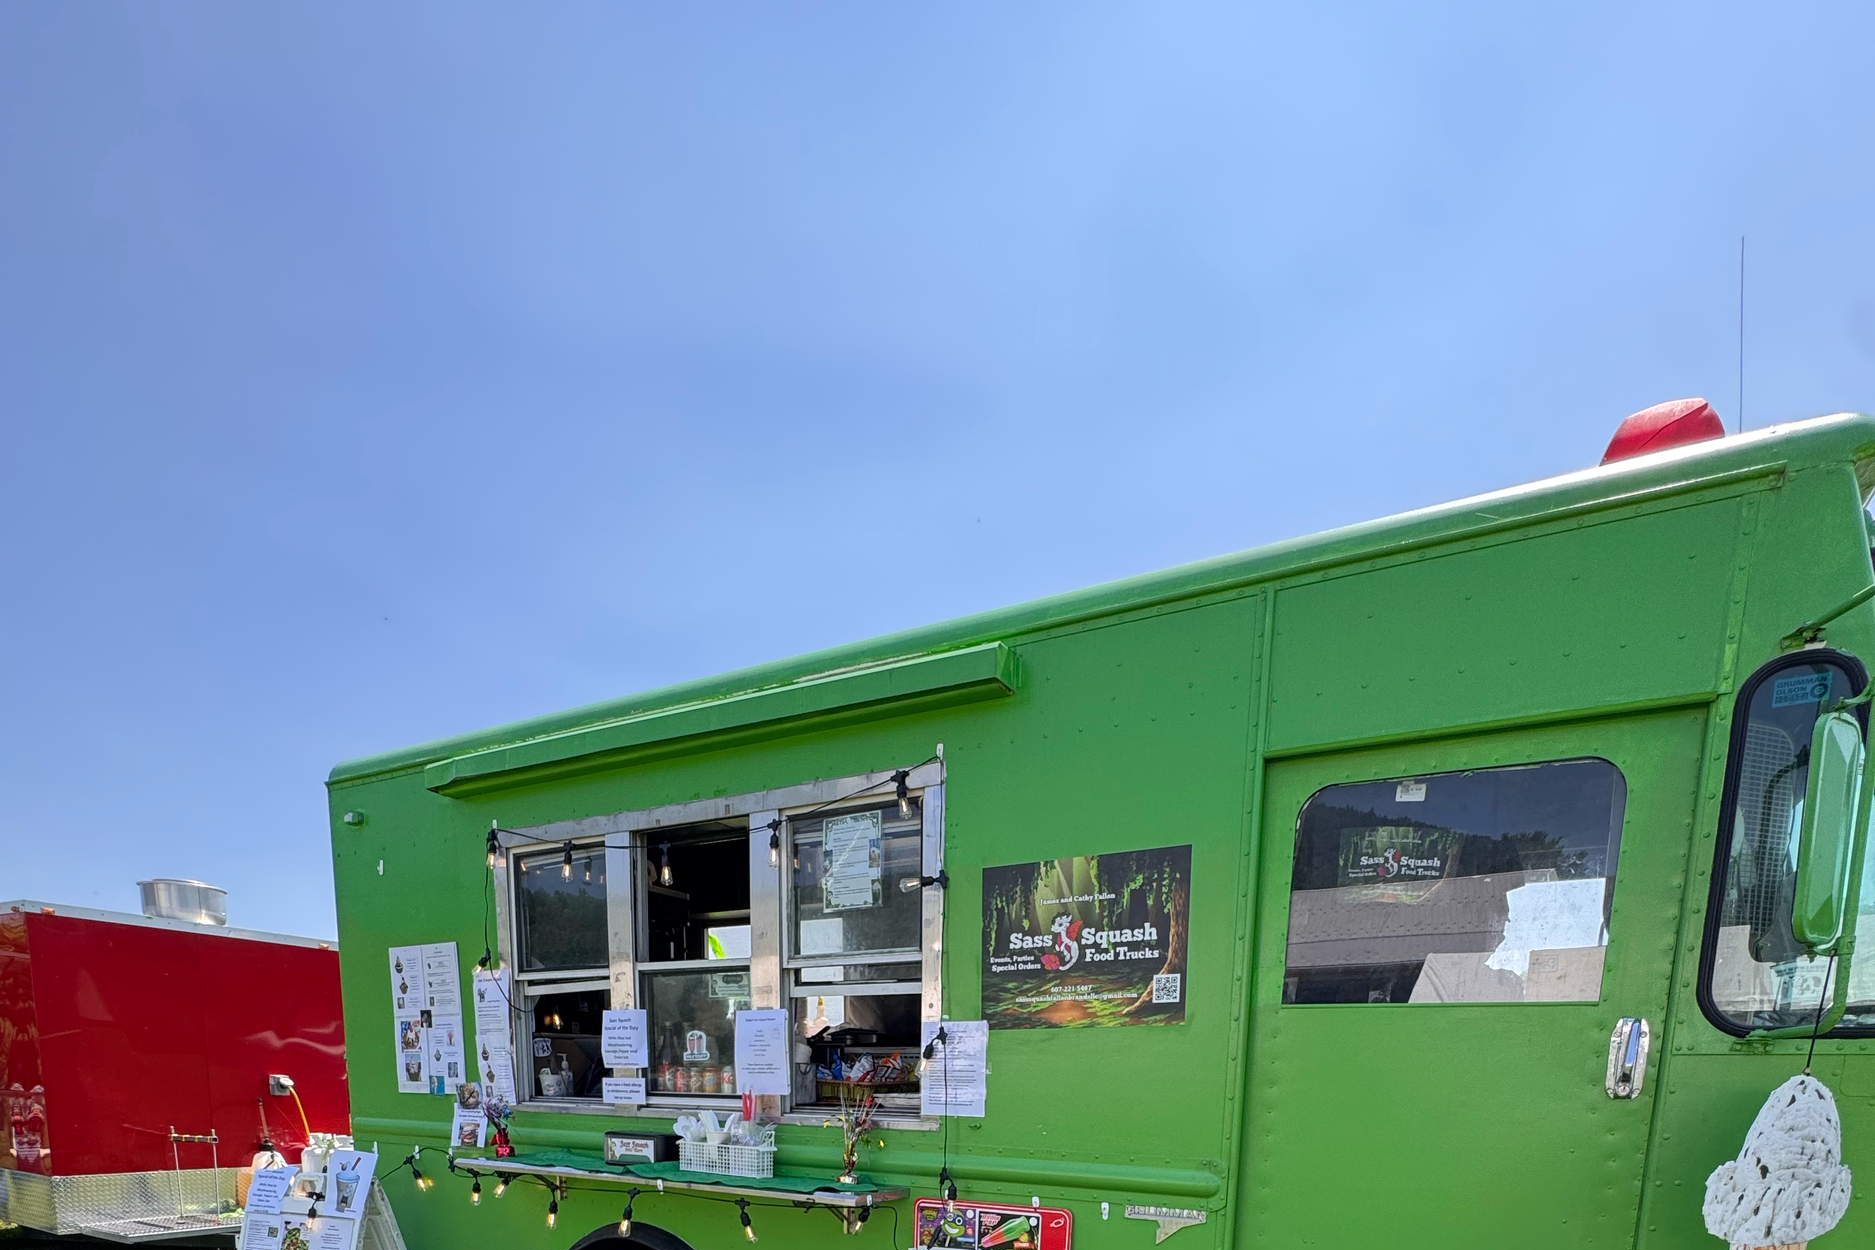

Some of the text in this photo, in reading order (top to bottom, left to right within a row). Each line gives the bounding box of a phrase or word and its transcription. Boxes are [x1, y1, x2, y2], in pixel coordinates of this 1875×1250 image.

[1776, 675, 1828, 689] GRUMMAN
[1776, 686, 1807, 696] OLSON
[1360, 855, 1441, 868] Sass Squash
[1401, 867, 1440, 877] Food Trucks
[1060, 895, 1073, 903] and
[1074, 894, 1093, 903] Cathy
[1094, 892, 1116, 900] Fallon
[1009, 922, 1158, 949] Sass Squash
[990, 956, 1012, 964] Events,
[1084, 946, 1160, 962] Food Trucks
[991, 962, 1041, 973] Special Orders
[1126, 1204, 1207, 1220] GRUMMAN
